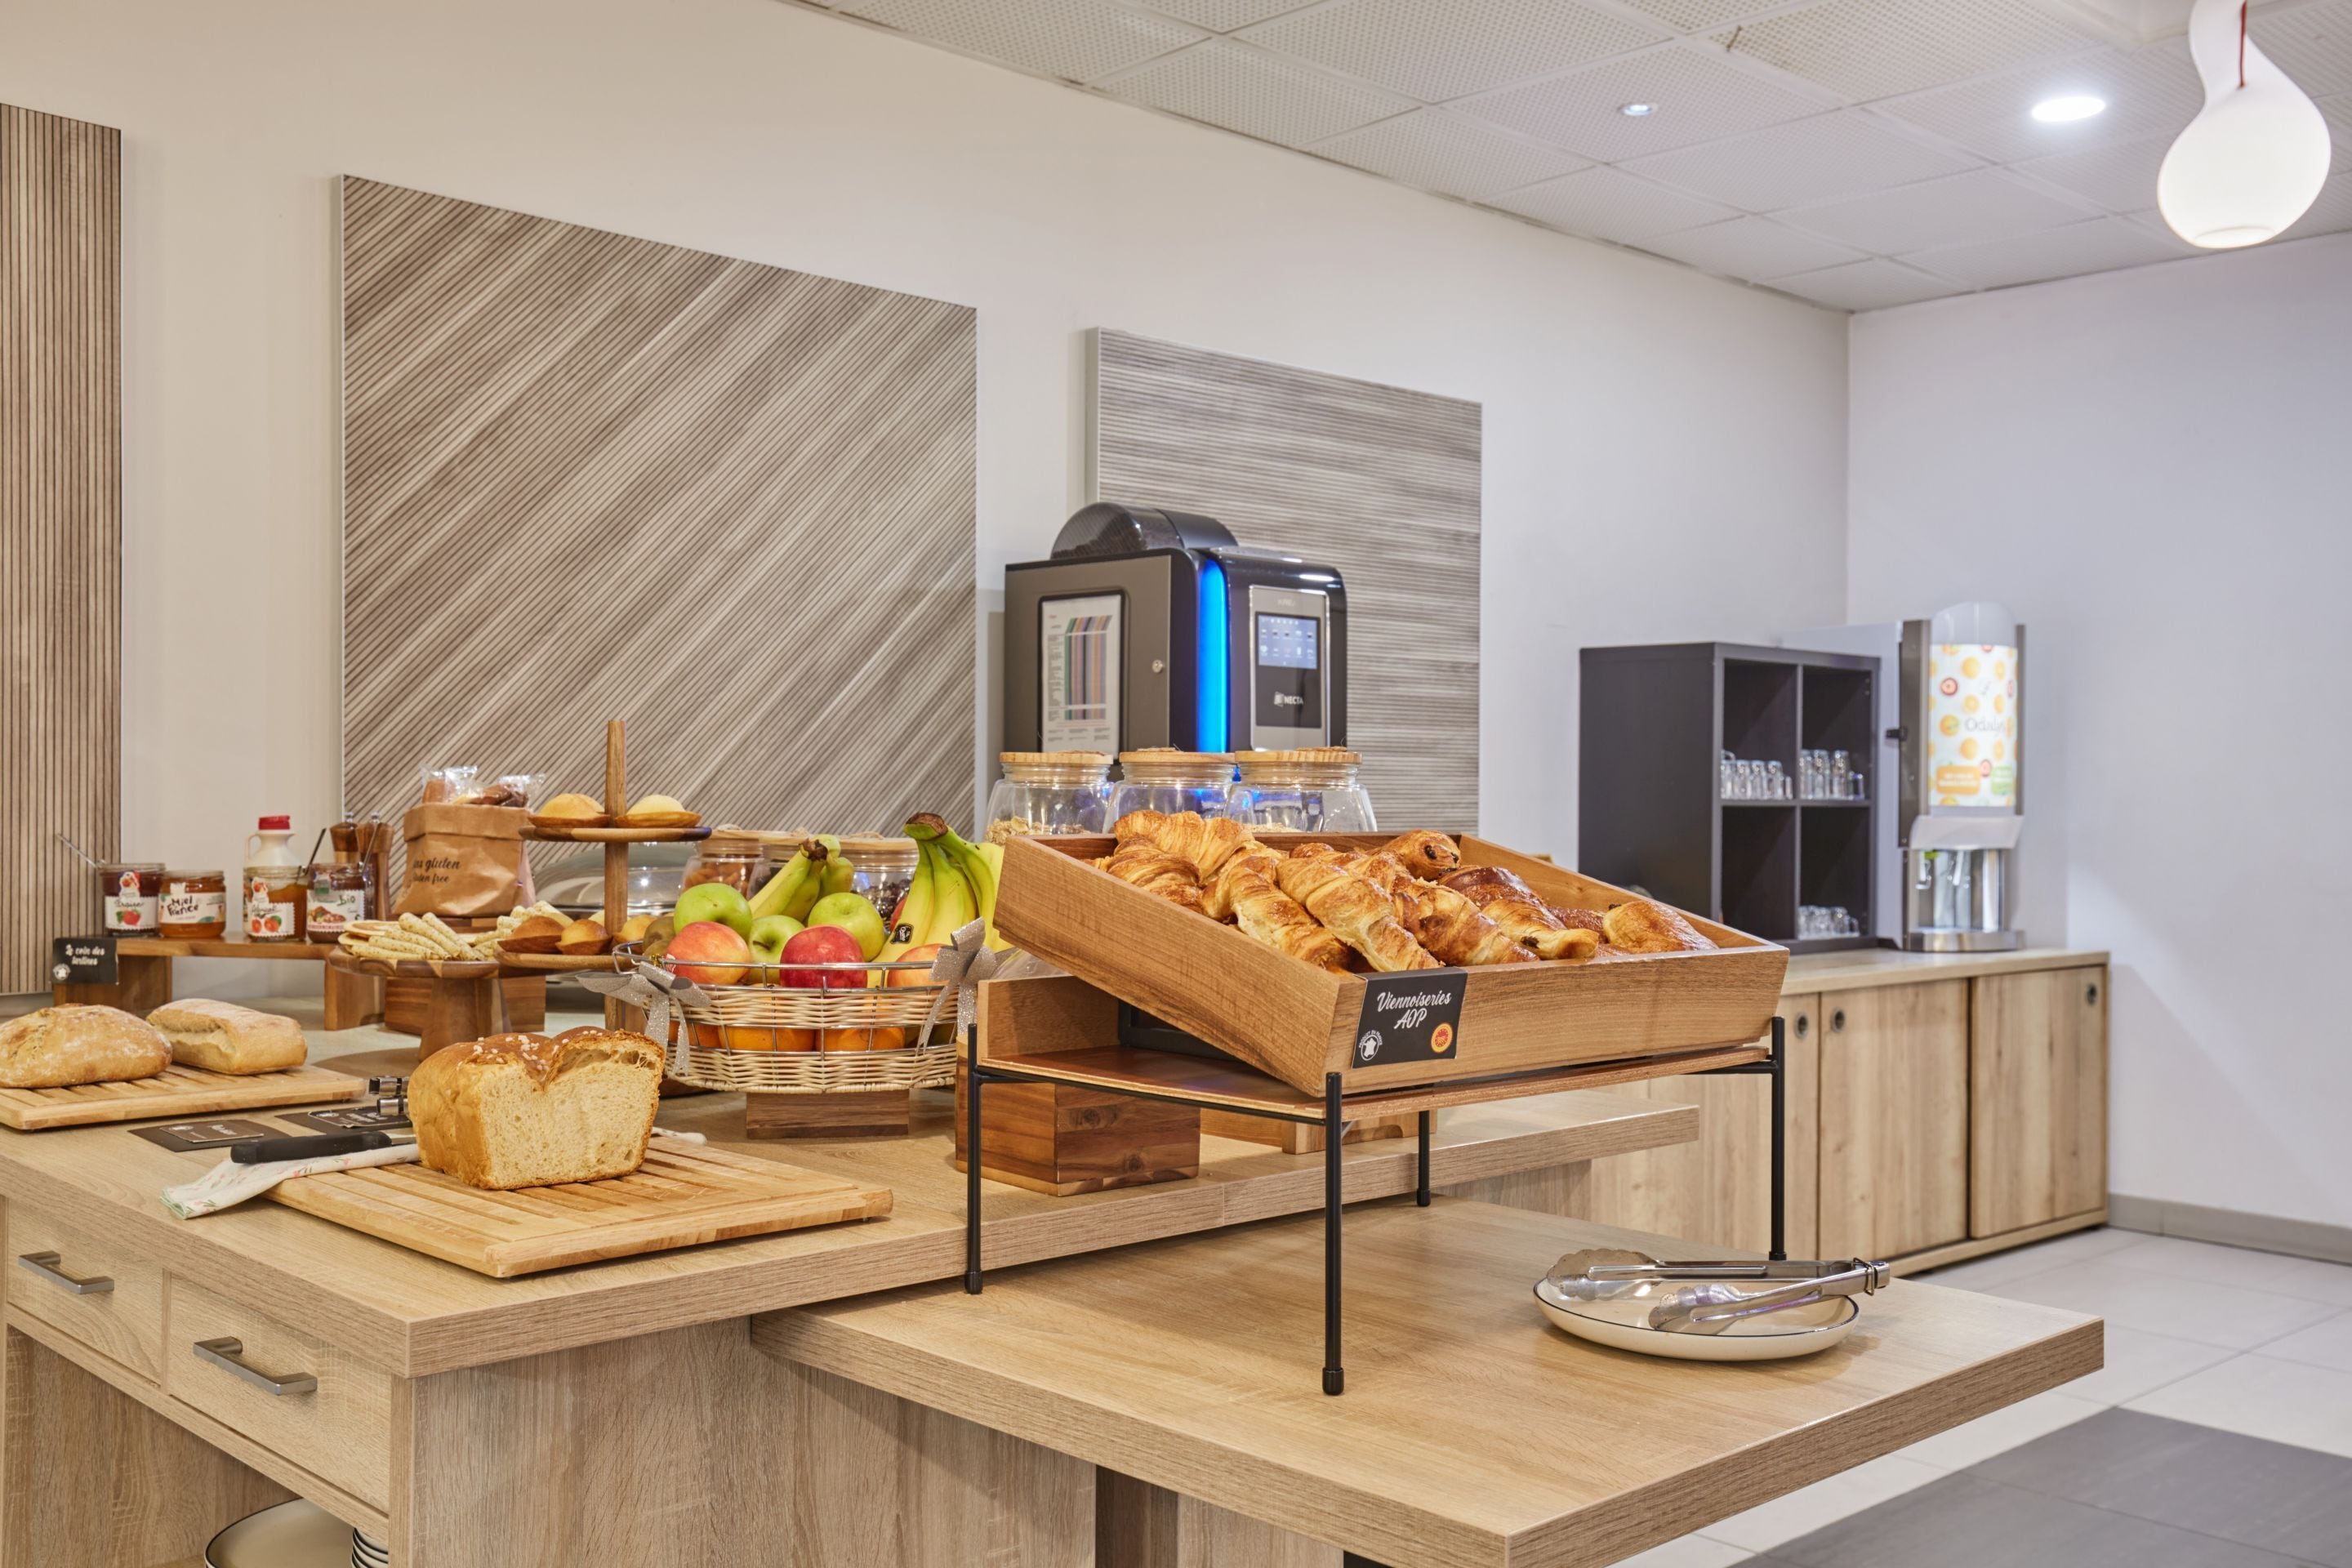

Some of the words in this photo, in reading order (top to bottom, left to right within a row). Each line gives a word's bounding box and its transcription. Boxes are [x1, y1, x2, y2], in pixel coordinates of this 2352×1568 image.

[1284, 696, 1304, 705] NECTA
[425, 857, 461, 872] gluten
[171, 895, 193, 906] Miel
[167, 903, 198, 916] France
[1377, 990, 1452, 1013] Viennoiseries
[1393, 1008, 1428, 1029] AOP
